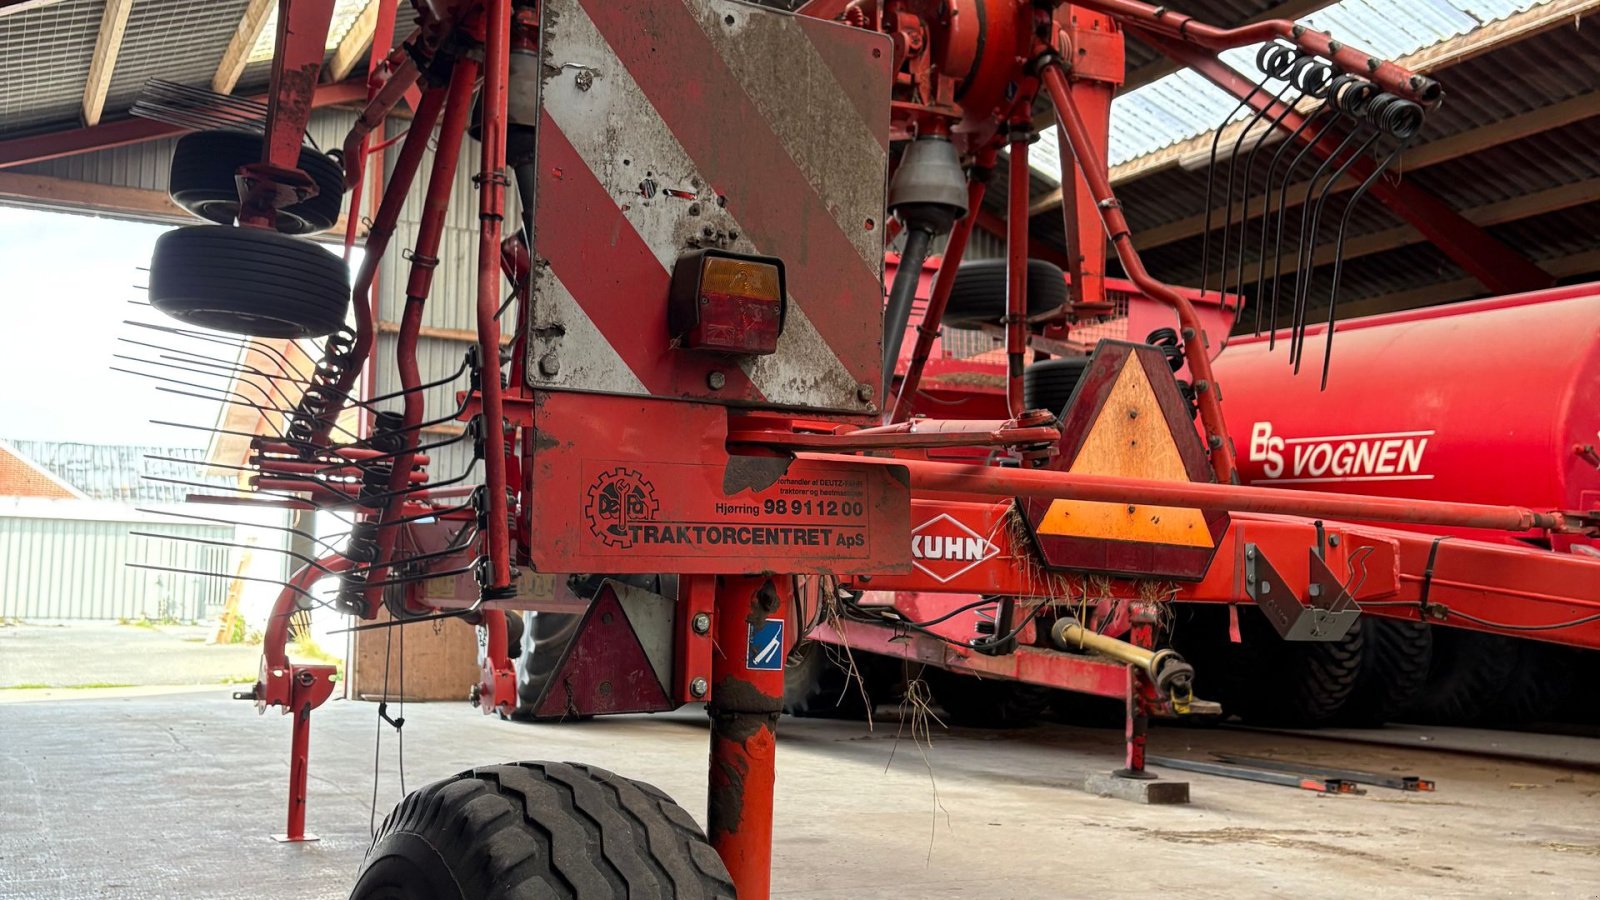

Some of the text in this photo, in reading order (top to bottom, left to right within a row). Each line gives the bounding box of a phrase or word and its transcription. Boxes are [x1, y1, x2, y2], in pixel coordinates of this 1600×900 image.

[1249, 421, 1428, 478] BS VOGNEN
[780, 488, 809, 496] traktorer
[809, 489, 818, 497] og
[715, 499, 863, 517] Hjørring 98 91 12 00
[628, 524, 865, 549] TRAKTORCENTRET ApS
[911, 535, 985, 561] KUHN
